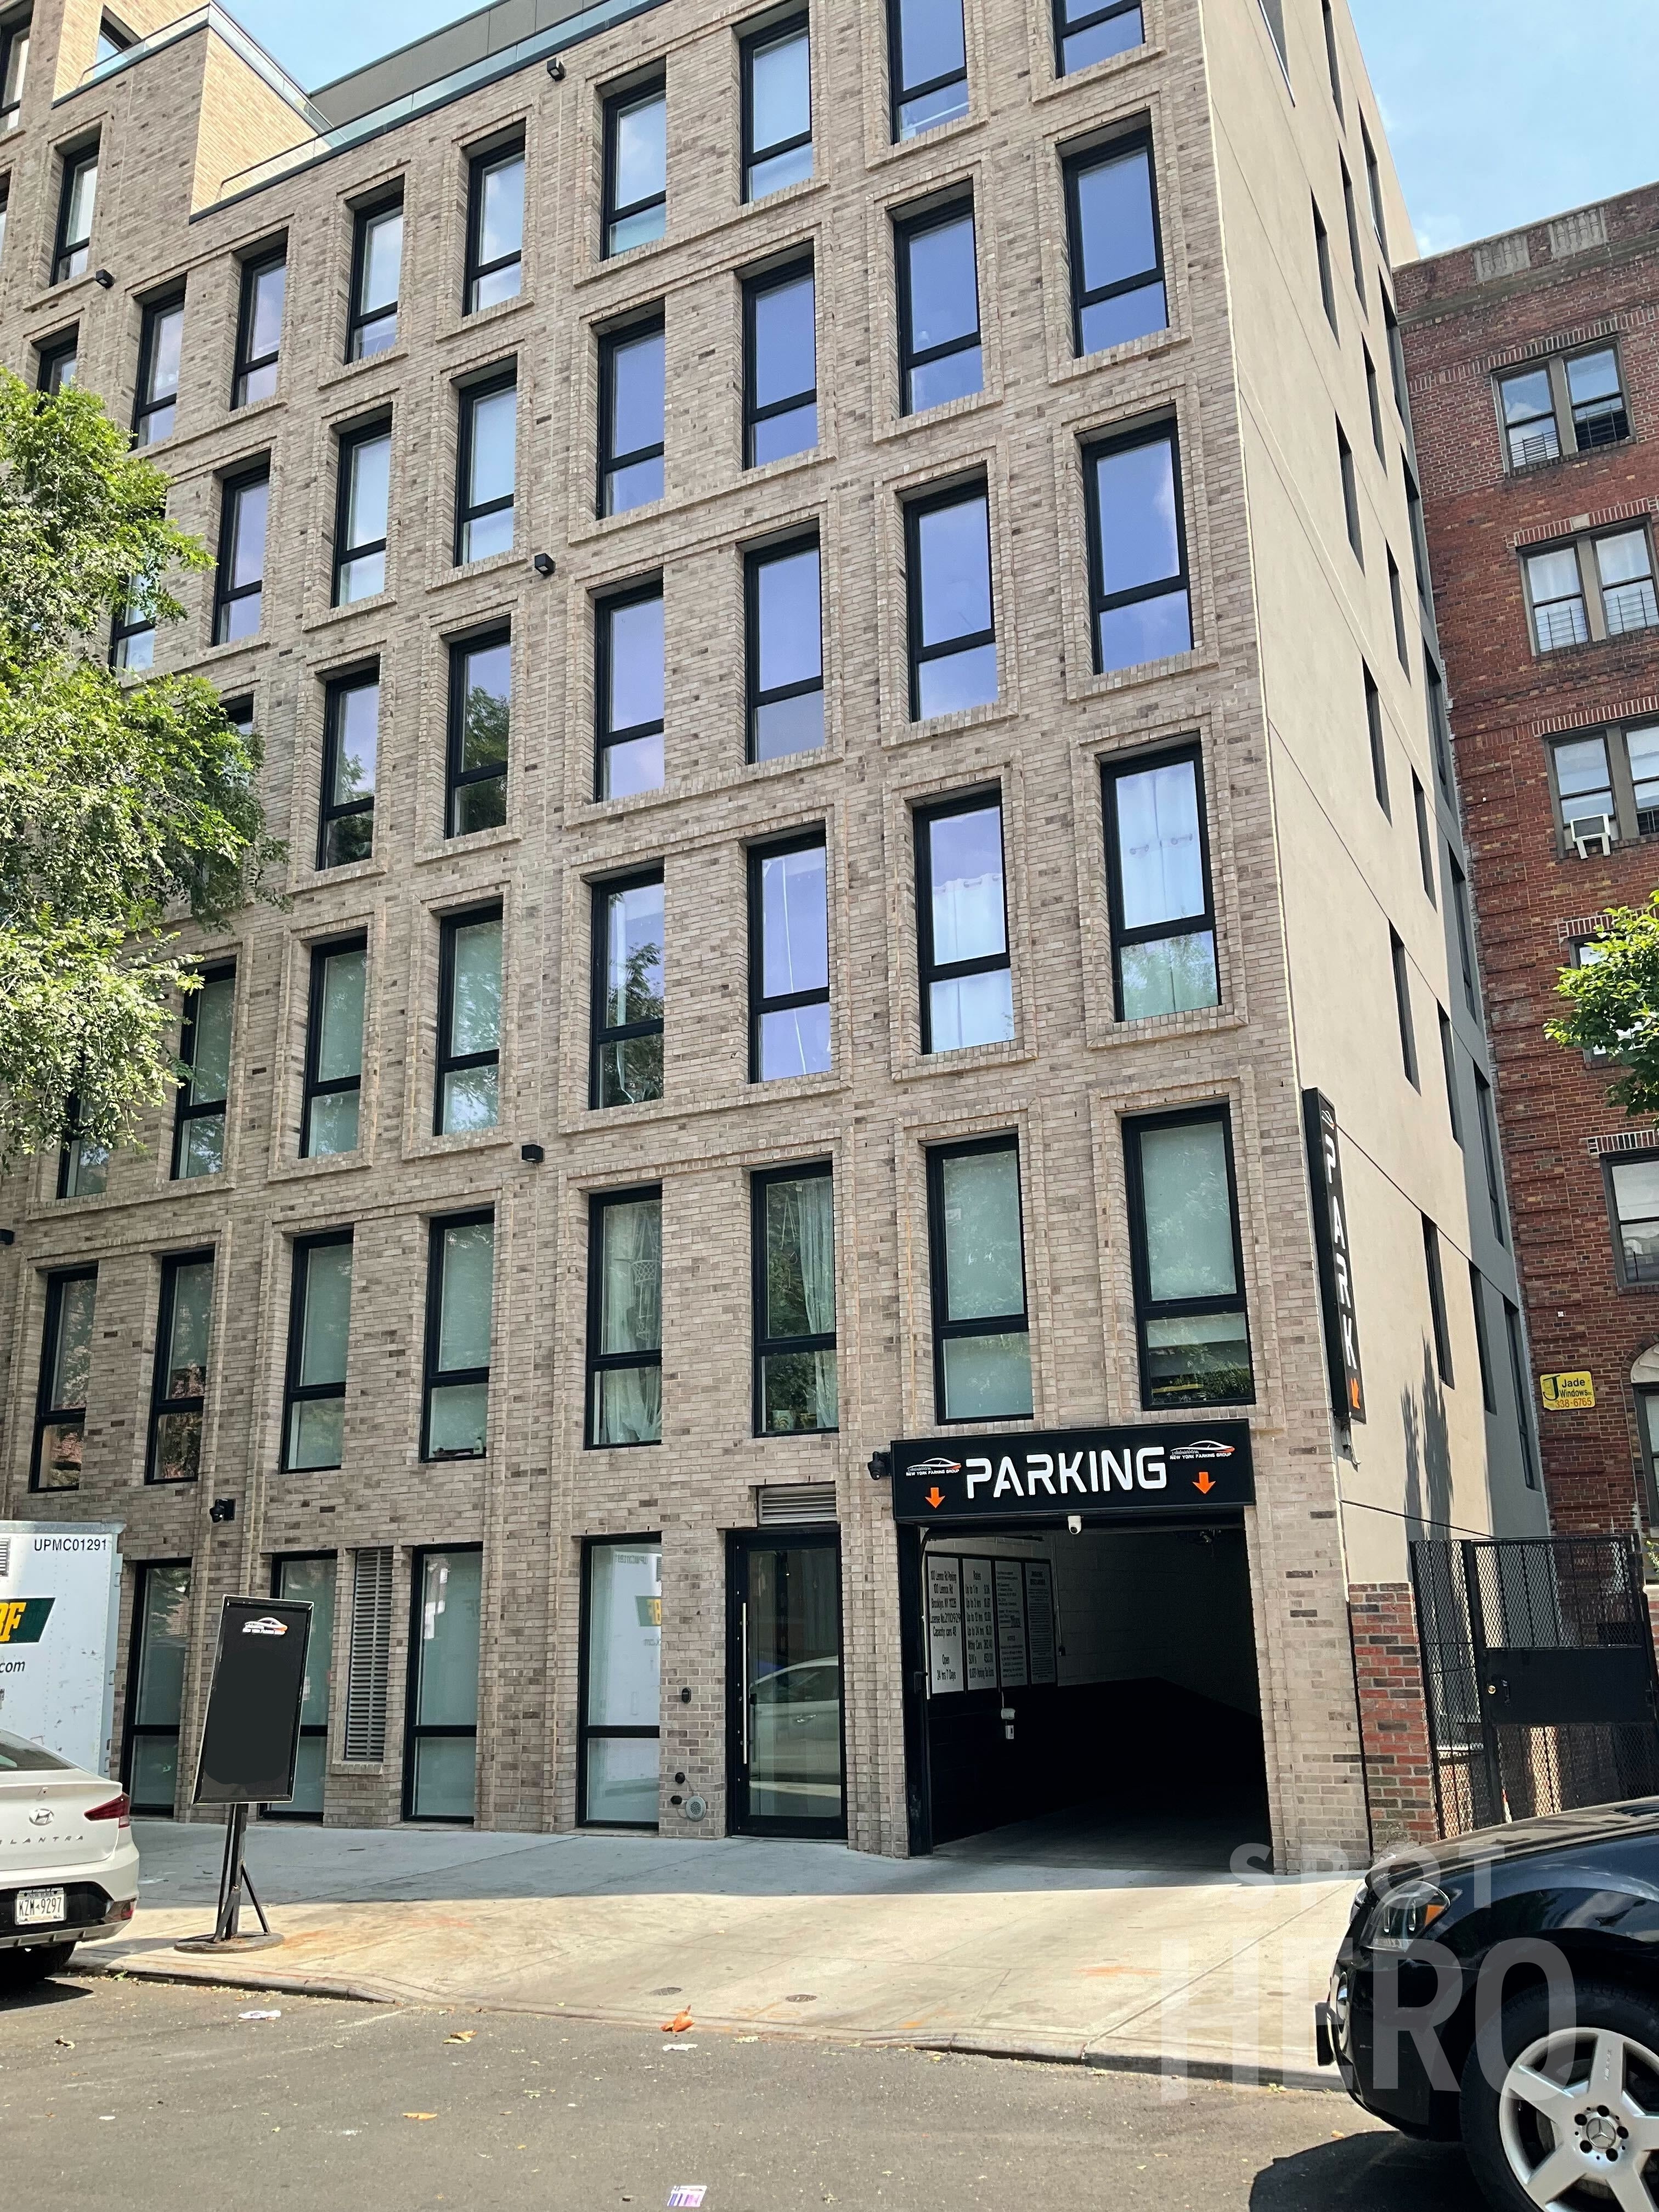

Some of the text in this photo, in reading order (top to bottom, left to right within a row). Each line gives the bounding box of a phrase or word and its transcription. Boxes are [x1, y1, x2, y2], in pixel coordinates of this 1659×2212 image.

[1325, 1133, 1357, 1370] PARK
[1561, 1378, 1585, 1388] Jade
[1559, 1389, 1588, 1398] Windows
[966, 1446, 1167, 1499] PARKING
[34, 1538, 106, 1551] UPMC01291
[41, 1897, 61, 1914] 9297
